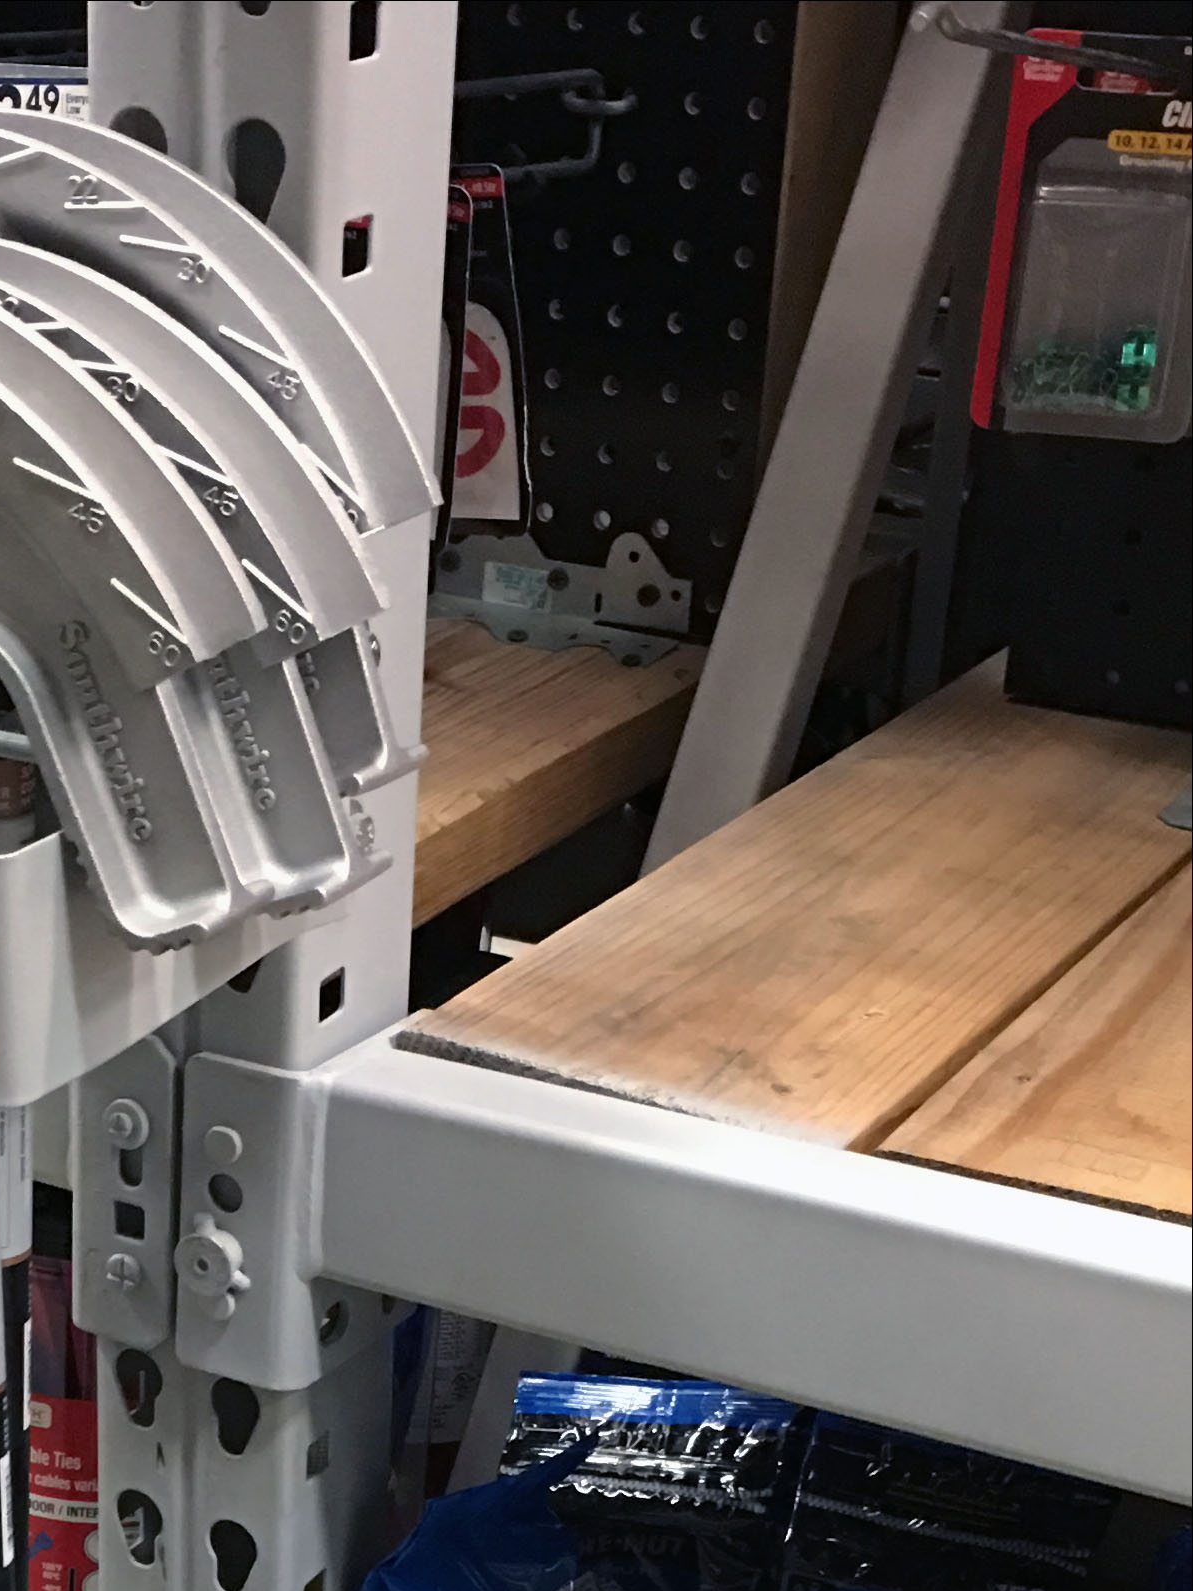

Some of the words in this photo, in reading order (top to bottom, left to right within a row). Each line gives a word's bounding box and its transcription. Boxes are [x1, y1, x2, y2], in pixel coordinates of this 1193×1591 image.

[67, 175, 97, 204] 22
[177, 258, 209, 284] 30
[107, 376, 140, 402] 30
[266, 371, 301, 400] 45
[204, 486, 239, 517] 45
[68, 502, 106, 534] 45
[276, 609, 306, 645] 60
[148, 631, 181, 667] 60
[54, 1451, 81, 1470] Ties
[34, 1475, 71, 1490] cables
